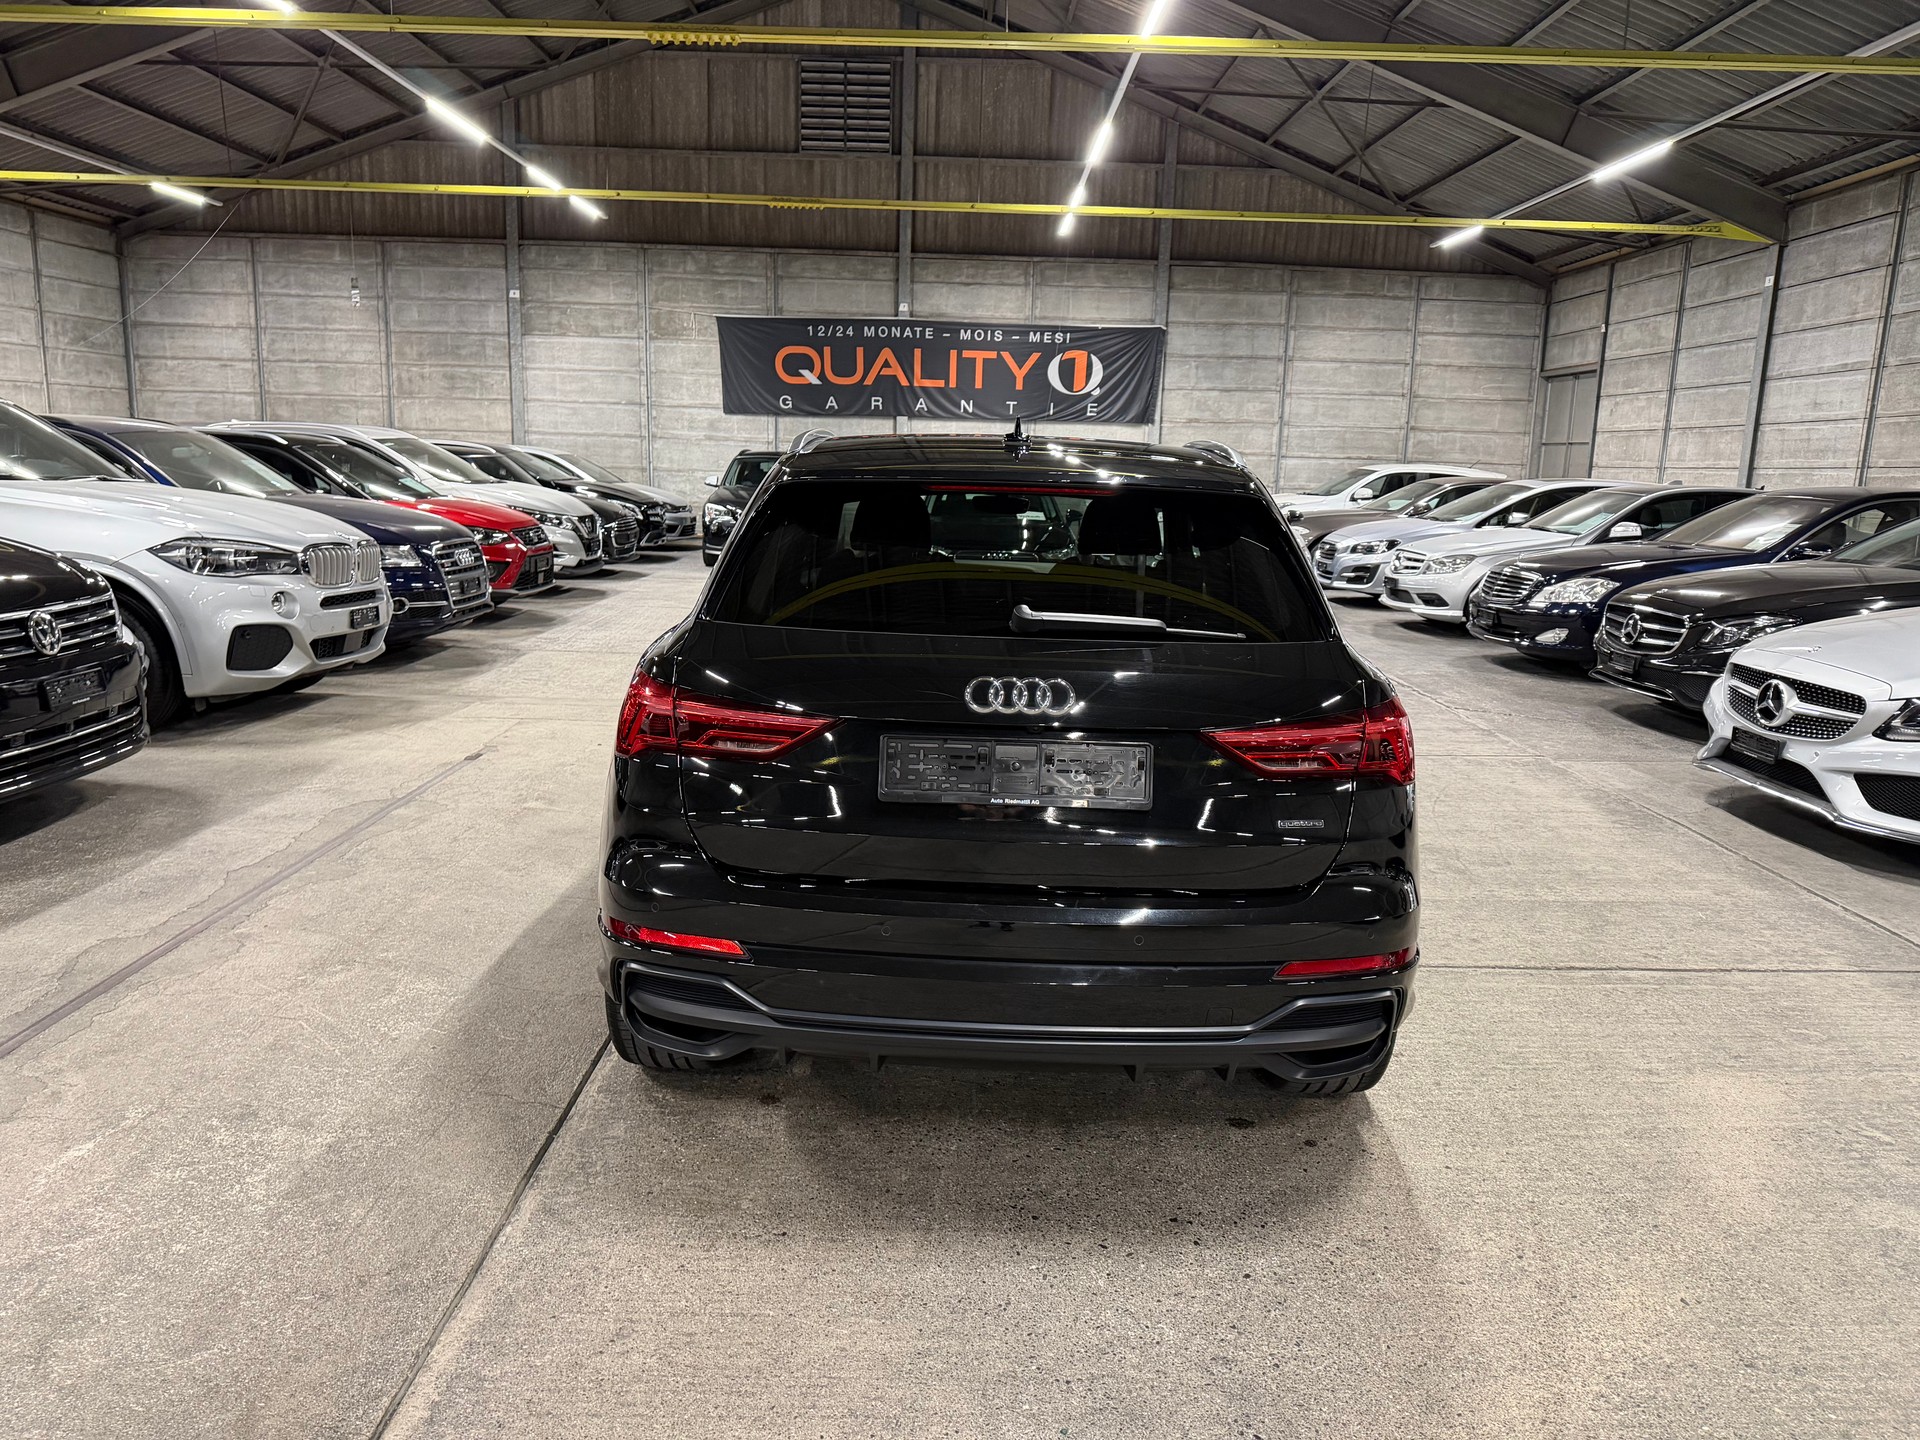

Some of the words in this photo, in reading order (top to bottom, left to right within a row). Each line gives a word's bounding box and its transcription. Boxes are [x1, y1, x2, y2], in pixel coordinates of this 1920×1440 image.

[807, 325, 854, 337] 12/24
[863, 326, 934, 339] MONATE
[960, 329, 1003, 341] MOIS
[1029, 332, 1071, 343] MESI
[775, 345, 1042, 390] QUALITY
[779, 395, 1098, 416] GARANTIE
